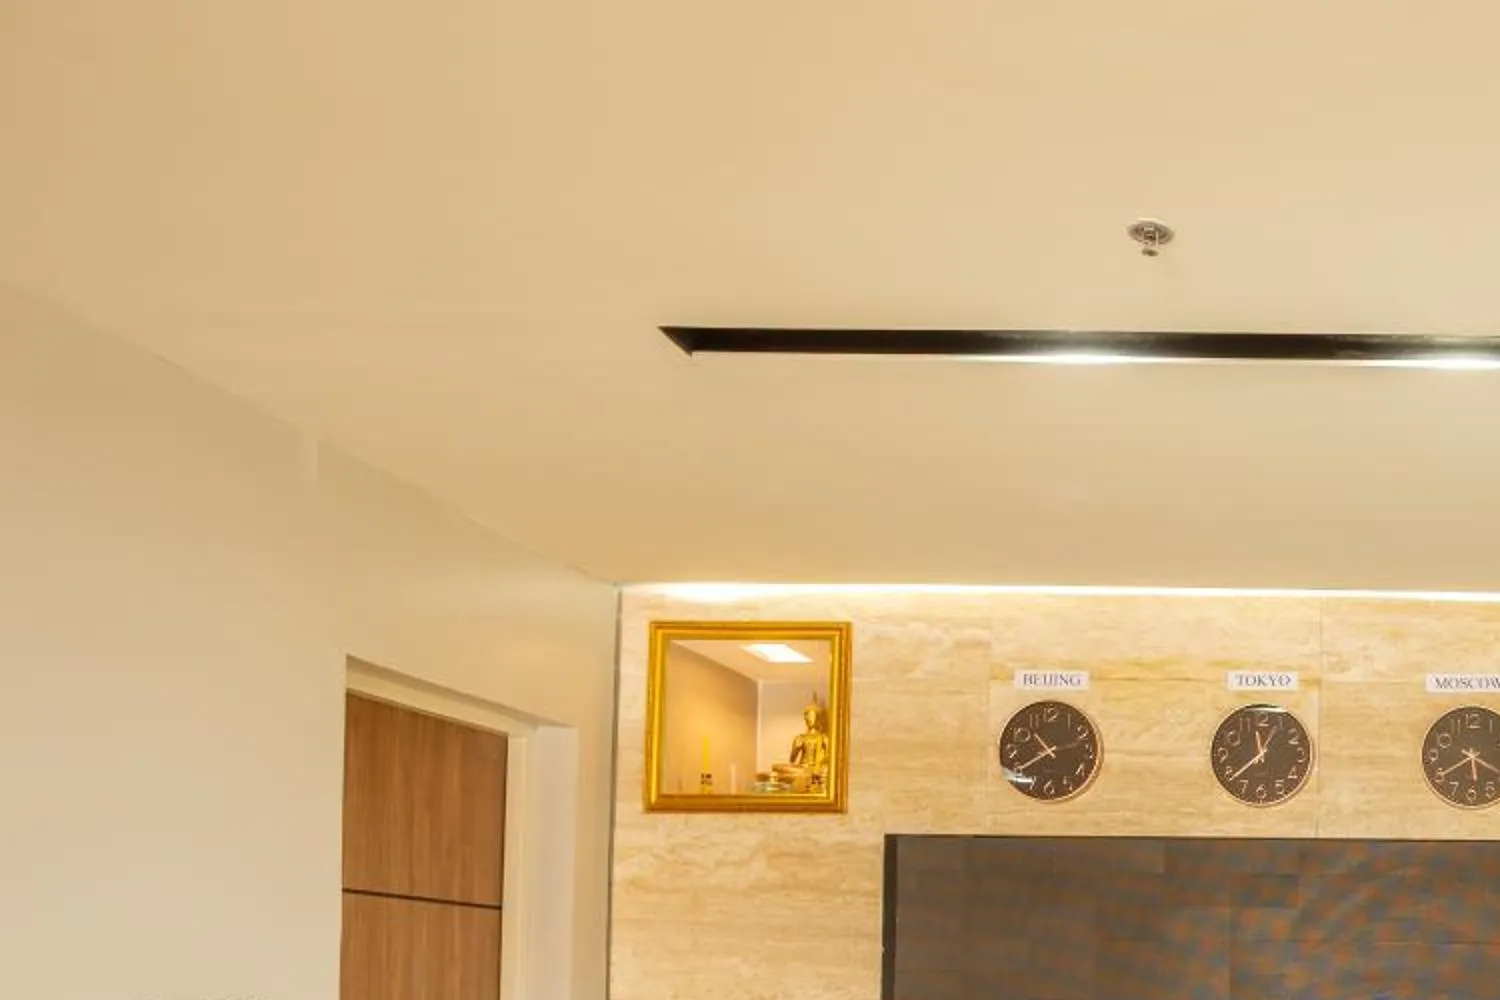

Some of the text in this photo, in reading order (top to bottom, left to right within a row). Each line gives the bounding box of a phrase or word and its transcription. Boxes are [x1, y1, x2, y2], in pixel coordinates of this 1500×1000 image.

[1023, 673, 1081, 686] BEIJING
[1234, 674, 1291, 686] TOKYO
[1465, 713, 1481, 728] 12
[1288, 728, 1299, 744] 2
[1239, 779, 1249, 794] 7
[1256, 784, 1267, 799] 6
[1275, 779, 1285, 795] 5
